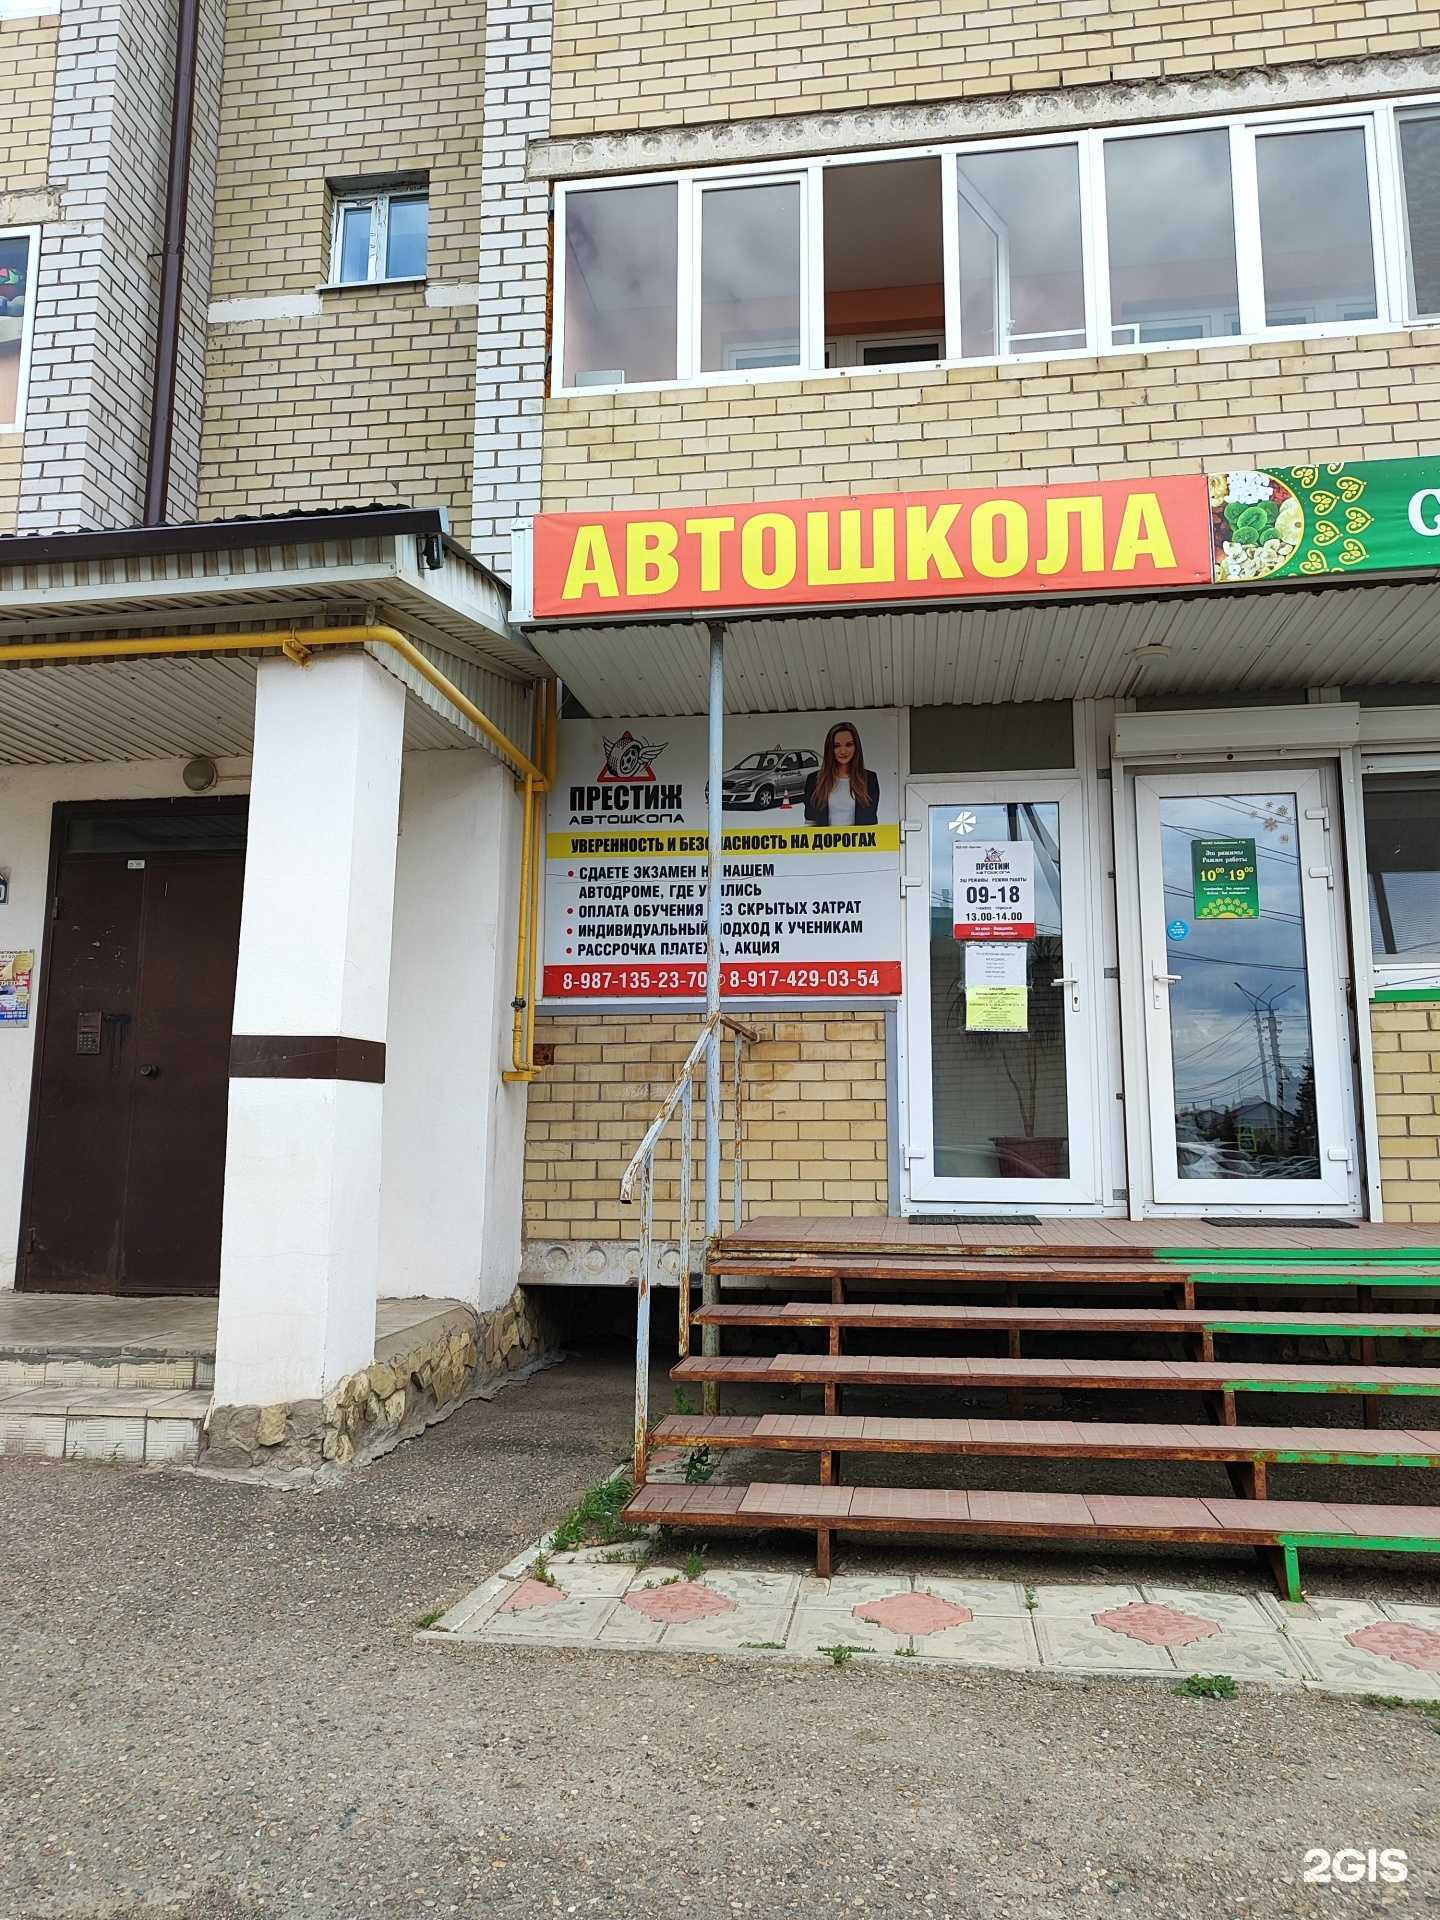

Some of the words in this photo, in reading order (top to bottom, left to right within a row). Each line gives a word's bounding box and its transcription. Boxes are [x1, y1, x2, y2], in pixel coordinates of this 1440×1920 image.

[561, 493, 1177, 600] АВТОШКОЛА
[570, 784, 682, 811] ПРЕСТИЖ
[571, 837, 664, 853] УВЕРЕННОСТЬ
[668, 837, 676, 851] И
[680, 835, 787, 851] БЕЗАСНОСТЬ
[791, 834, 807, 848] НА
[812, 832, 877, 850] ДОРОГАХ
[579, 866, 629, 881] СДАЕТЕ
[634, 865, 697, 879] ЭКЗАМЕН
[723, 864, 775, 877] НАШЕМ
[579, 885, 664, 900] АВТОДРОМЕ,
[669, 884, 694, 899] ГДЕ
[699, 884, 762, 898] УЛИСЬ
[966, 886, 1020, 904] 09-18
[579, 904, 629, 918] ОПЛАТА
[634, 903, 703, 917] ОБУЧЕНИЯ
[738, 901, 807, 916] СКРЫТЫХ
[812, 901, 861, 914] ЗАТРАТ
[966, 912, 1022, 921] 13.00-14.00
[578, 920, 708, 938] ИНДИВИДУАЛЬНЫЙ
[719, 921, 770, 937] ОДХОД
[775, 922, 783, 934] К
[788, 920, 863, 934] УЧЕНИКАМ
[578, 942, 656, 956] РАССРОЧКА
[735, 941, 780, 956] АКЦИЯ
[563, 971, 708, 990] 8-987-135-23-70
[730, 969, 879, 988] 8-917-429-03-54
